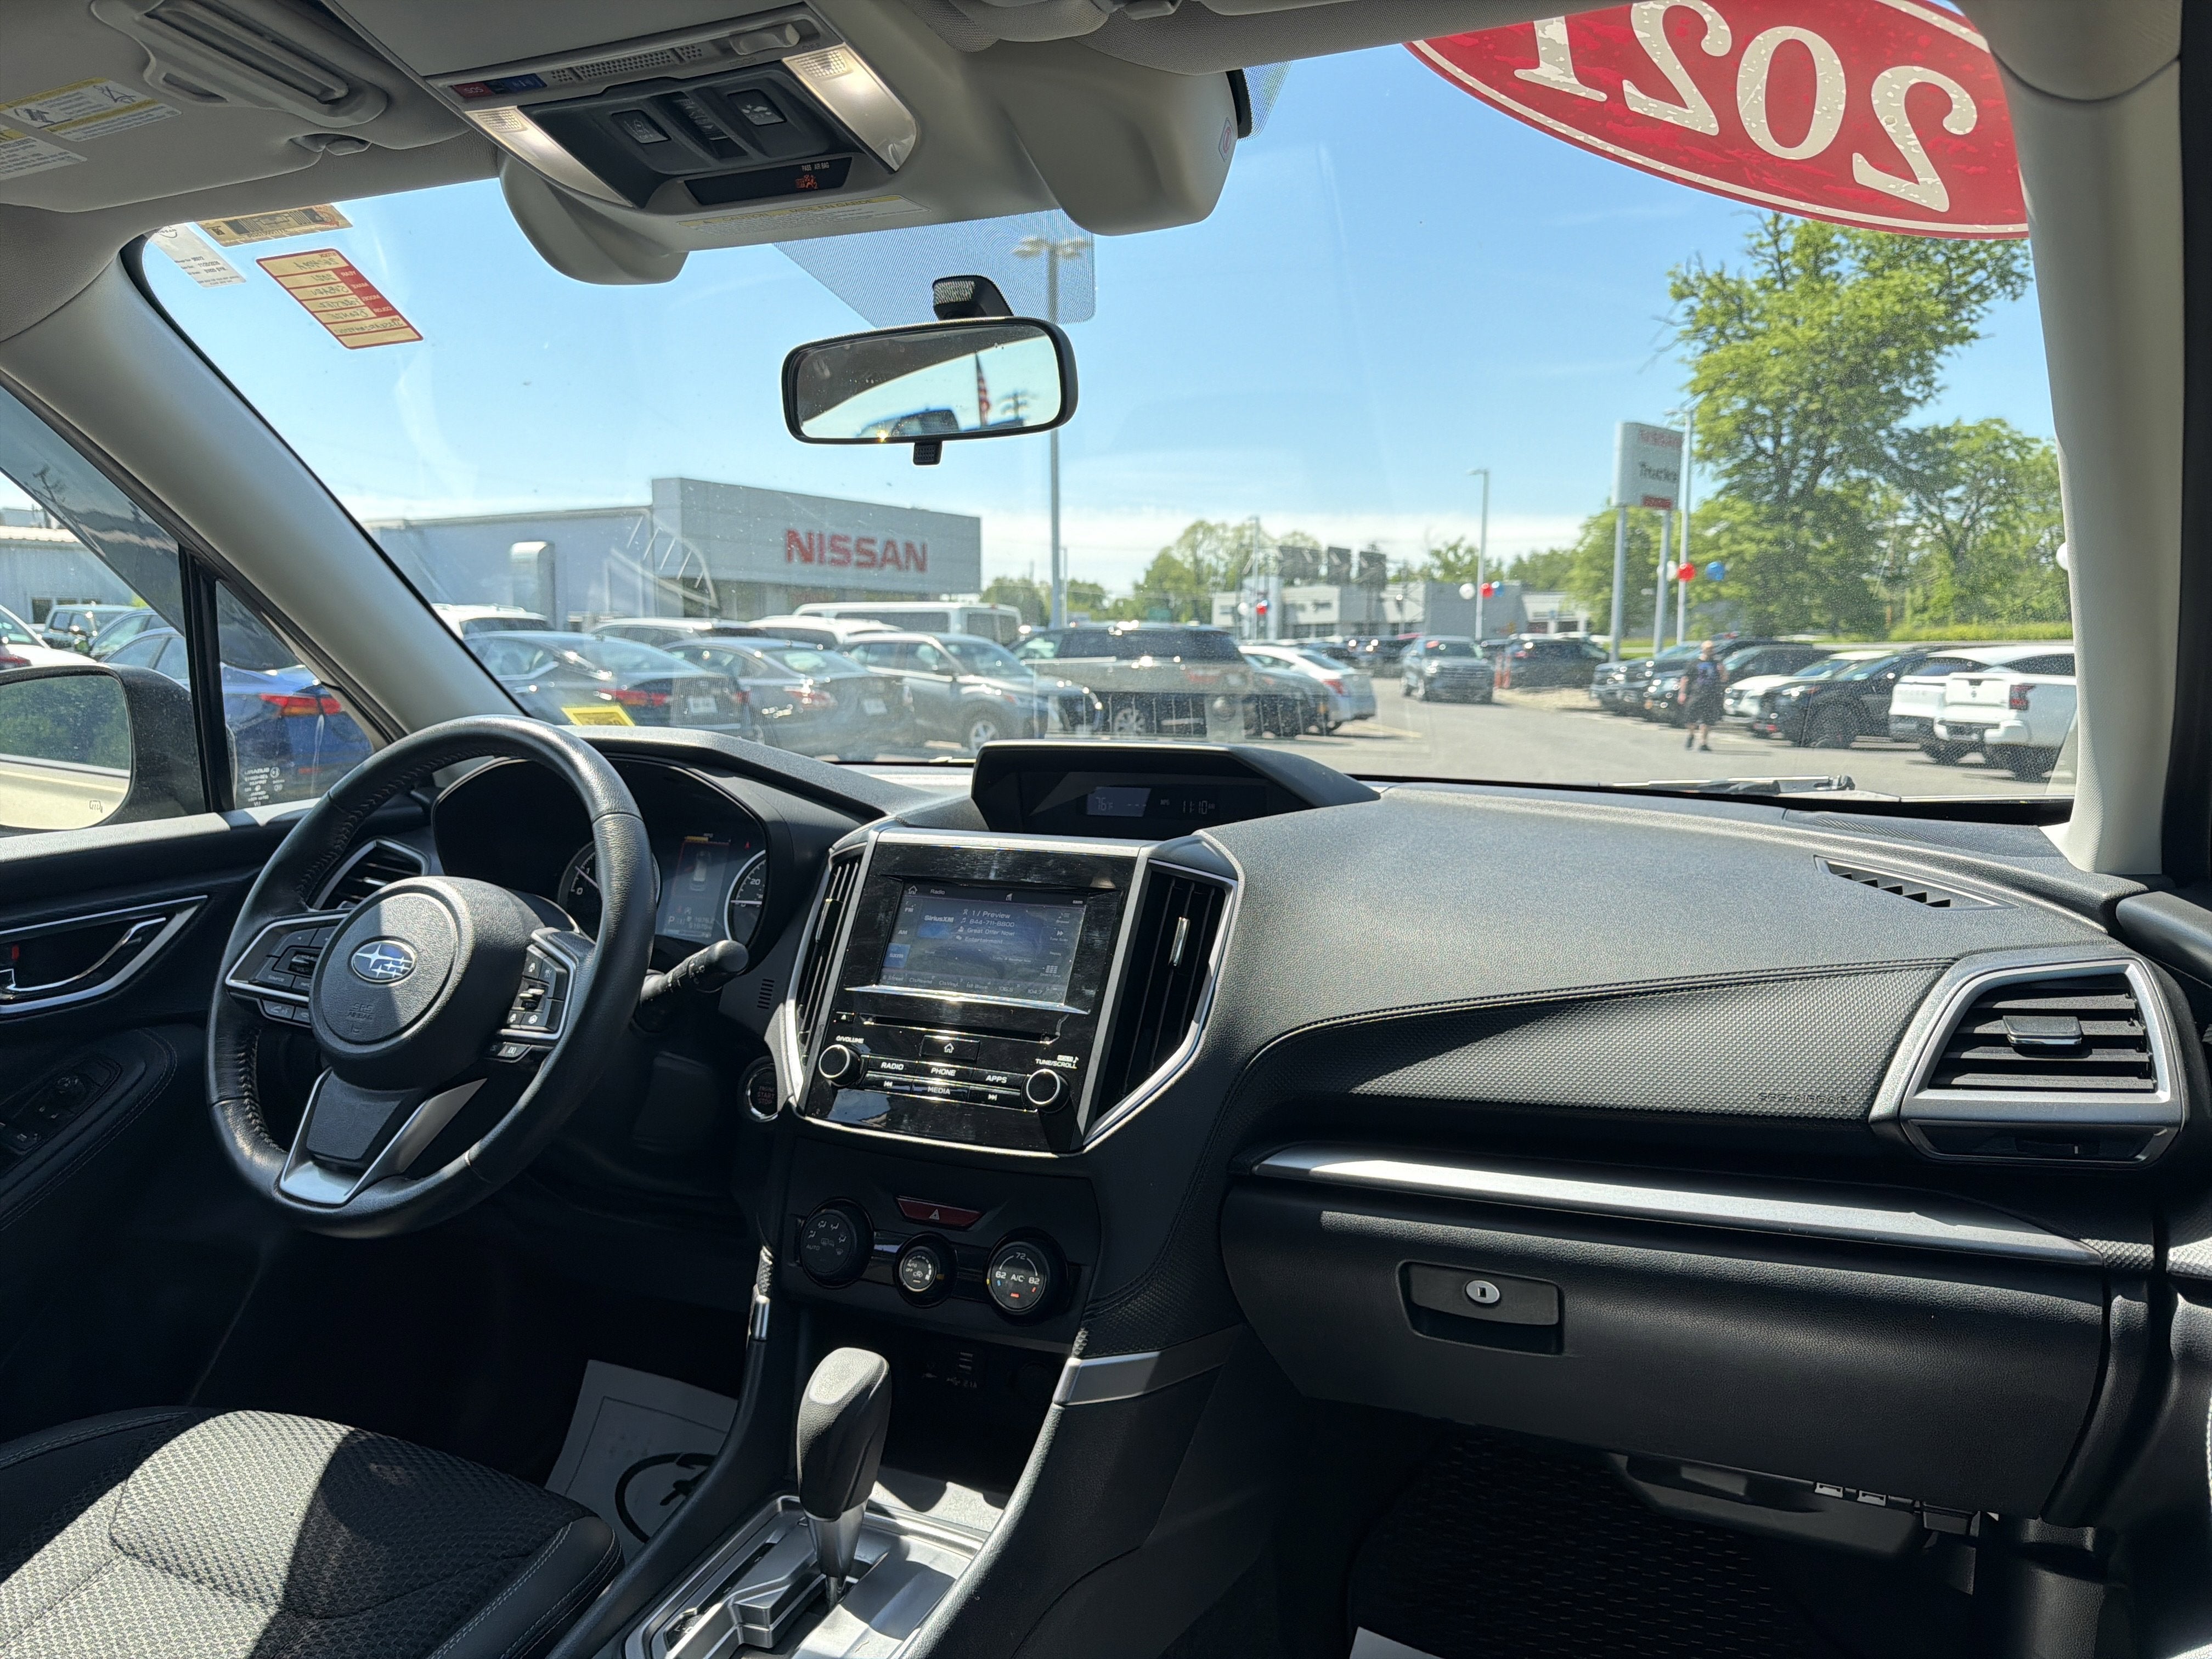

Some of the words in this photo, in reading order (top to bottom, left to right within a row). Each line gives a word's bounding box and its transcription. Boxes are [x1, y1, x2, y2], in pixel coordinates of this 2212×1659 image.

[786, 528, 927, 572] NISSAN
[969, 919, 1015, 928] 844-711-8800
[353, 1002, 374, 1012] SRS
[347, 1012, 373, 1020] AIRBAG
[881, 1062, 904, 1070] RADIO
[1035, 1058, 1077, 1069] TUNE/SCROLL
[930, 1067, 956, 1076] PHONE
[985, 1075, 1008, 1084] APPS
[927, 1086, 951, 1094] MEDIA
[995, 1271, 1007, 1279] 62
[1010, 1273, 1024, 1282] A/C
